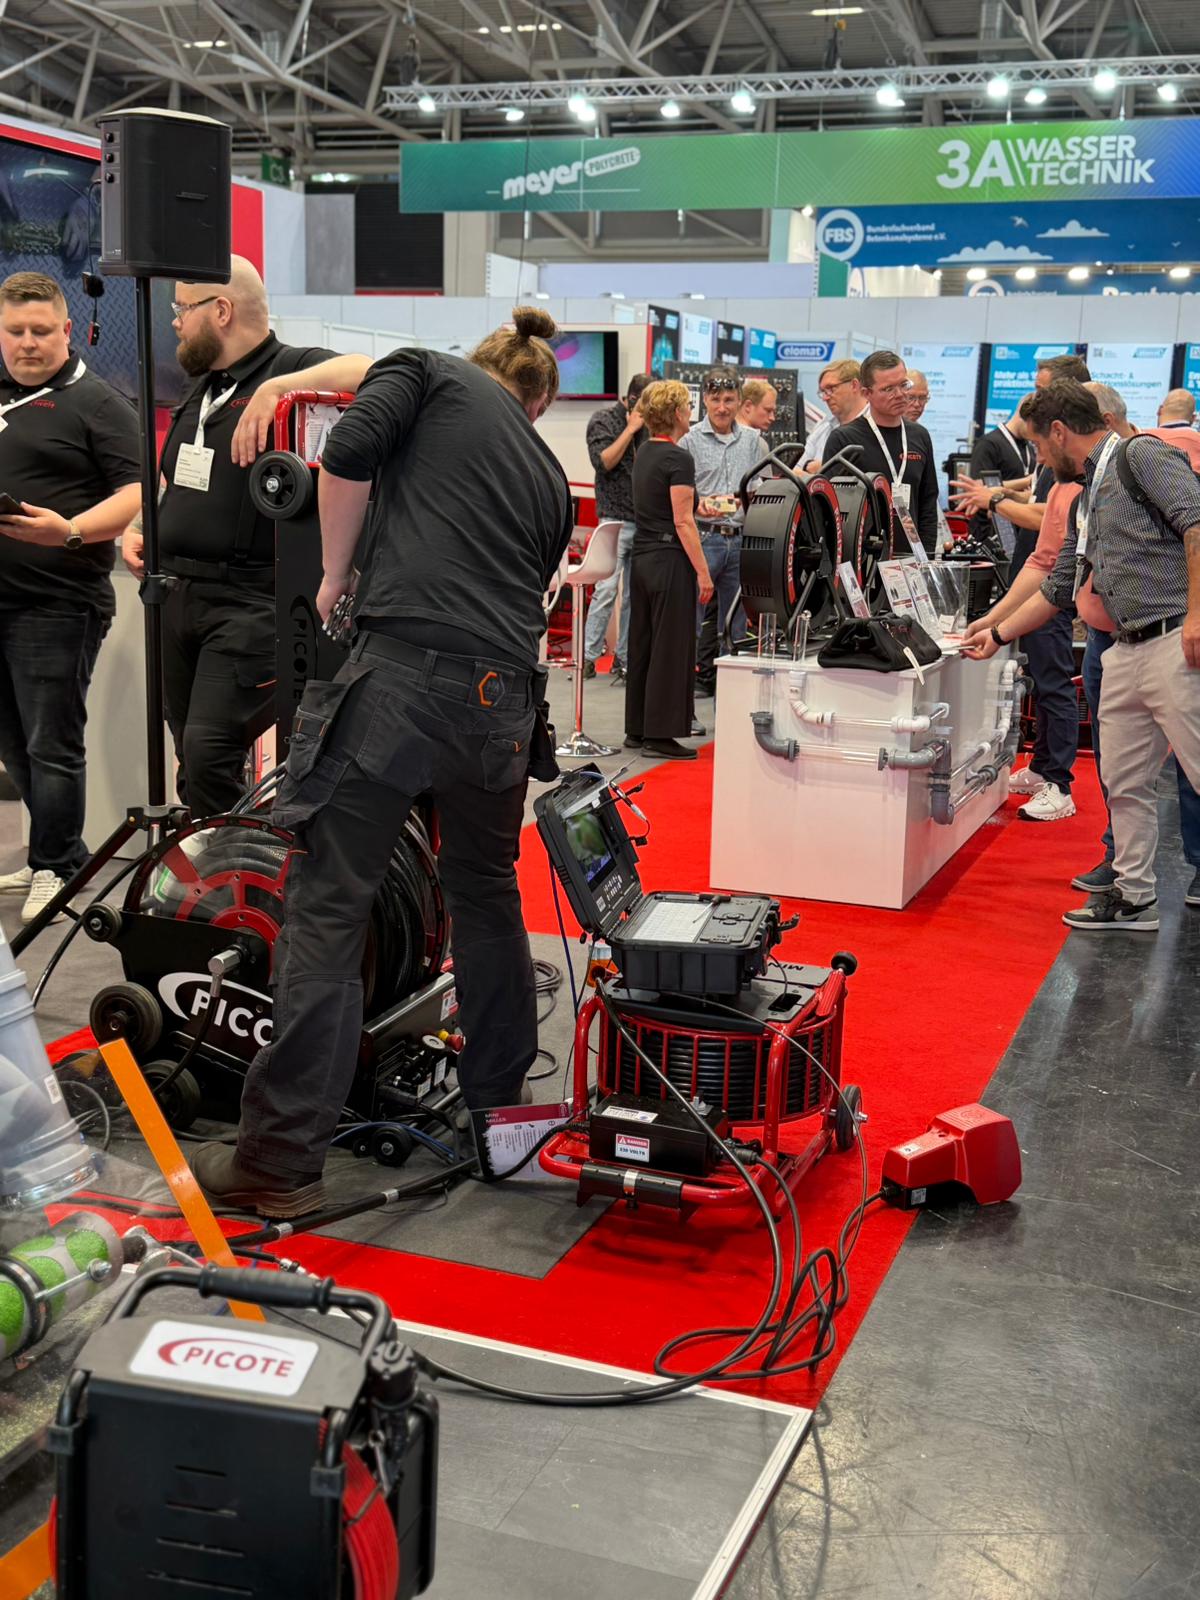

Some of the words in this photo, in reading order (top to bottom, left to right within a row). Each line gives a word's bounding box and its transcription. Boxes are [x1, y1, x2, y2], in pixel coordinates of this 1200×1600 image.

[1016, 135, 1137, 161] WASSER
[588, 151, 636, 173] POLYCRETE
[1026, 158, 1156, 186] TECHNIK
[503, 161, 583, 200] meyer
[825, 227, 854, 243] FBS
[783, 346, 822, 357] elomat
[767, 962, 804, 971] MIN
[190, 988, 274, 1047] PICO
[183, 1347, 294, 1378] PICOTE
